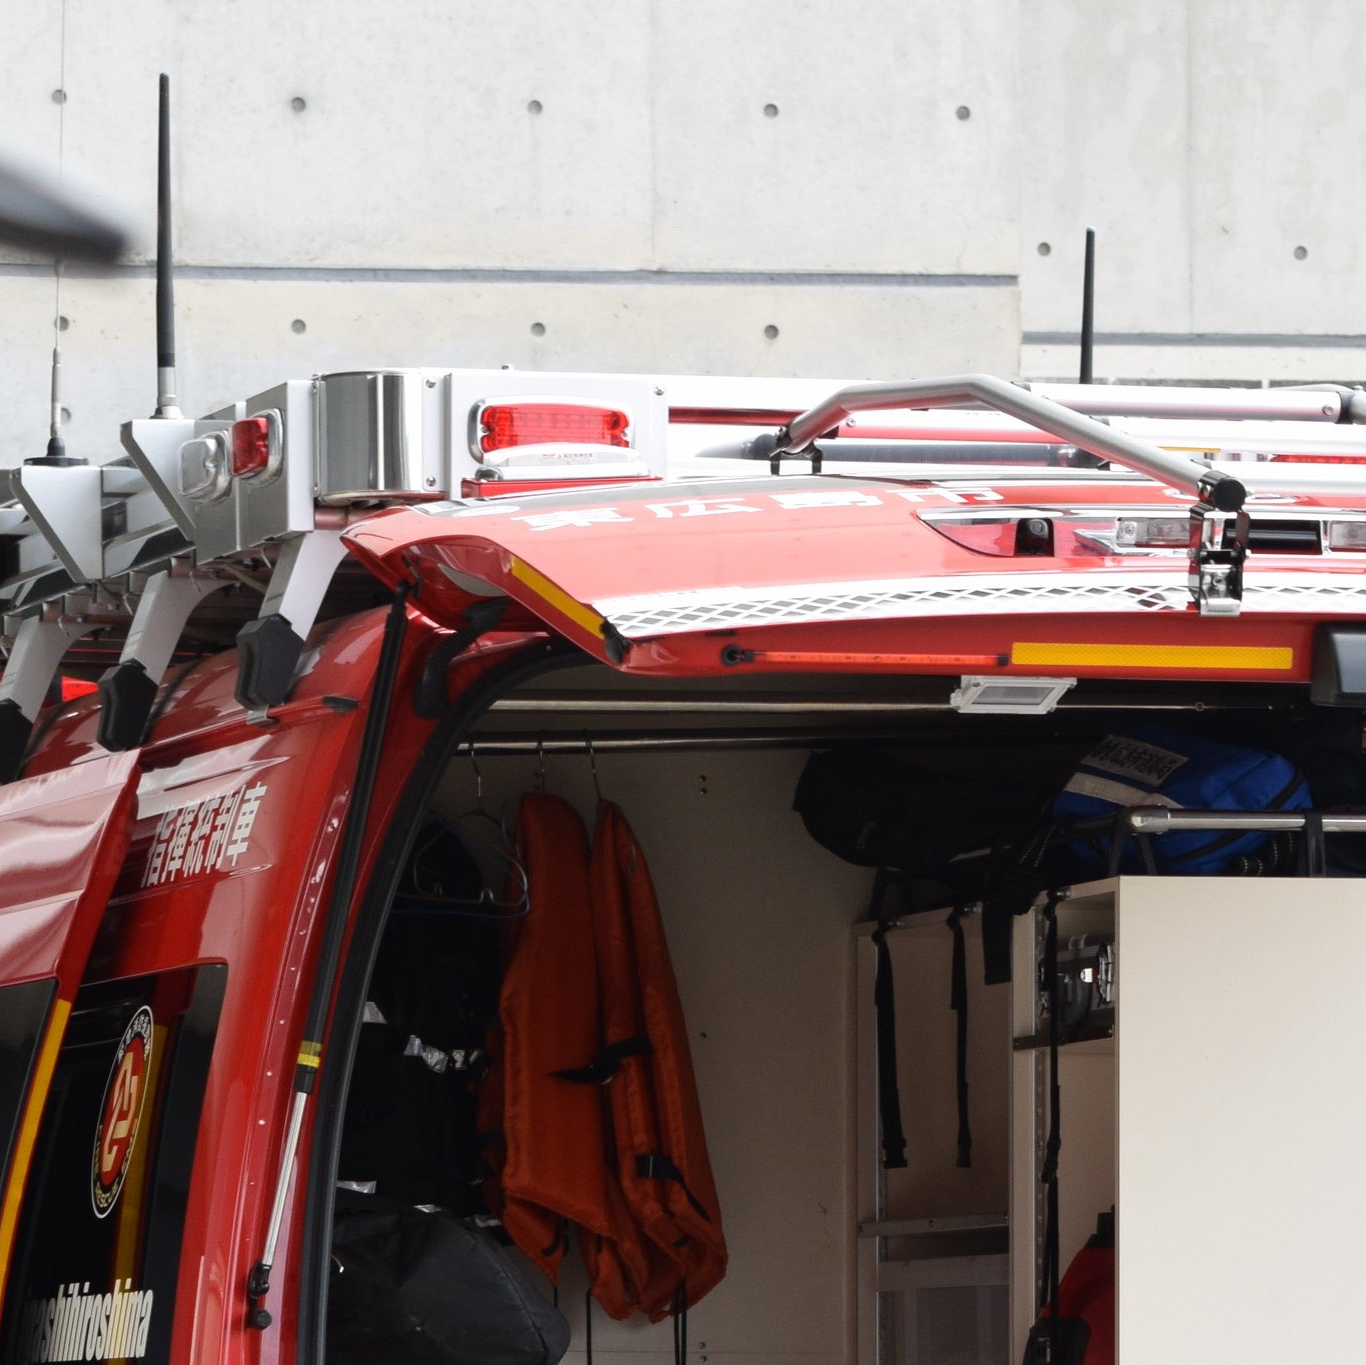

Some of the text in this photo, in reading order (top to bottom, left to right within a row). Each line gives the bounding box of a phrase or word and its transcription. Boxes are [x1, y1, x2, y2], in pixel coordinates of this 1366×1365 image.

[511, 486, 1006, 532] 東広島市
[141, 781, 268, 888] 指揮統制車
